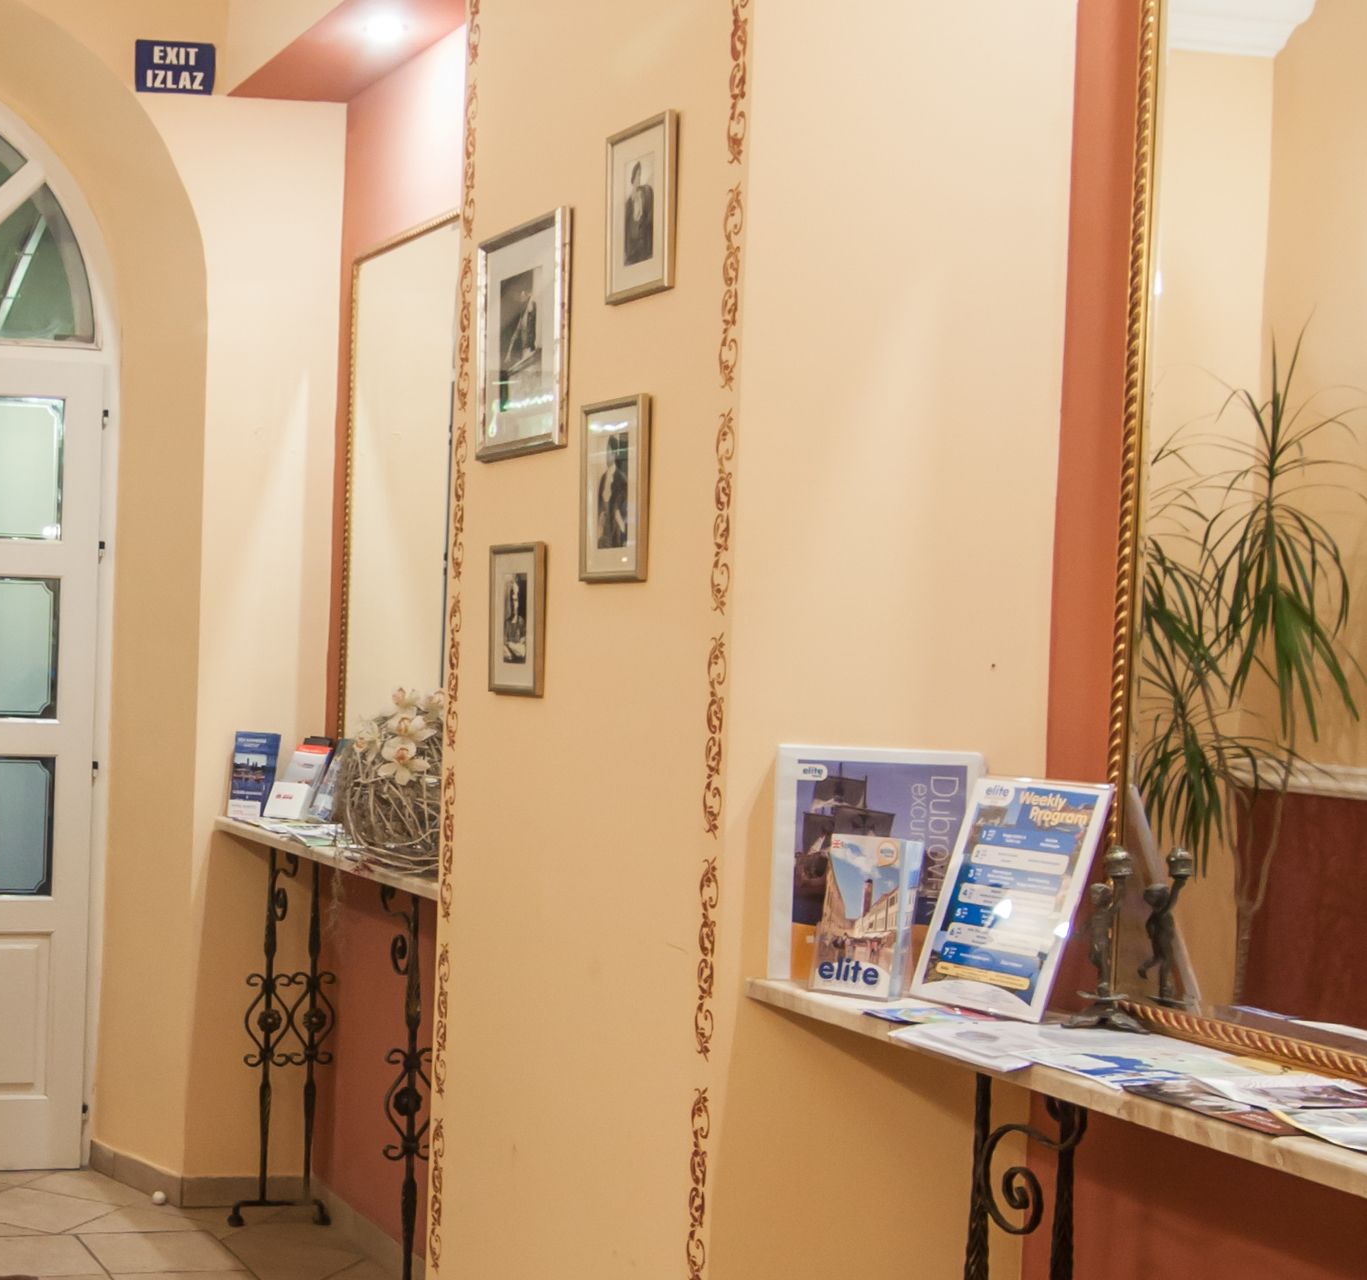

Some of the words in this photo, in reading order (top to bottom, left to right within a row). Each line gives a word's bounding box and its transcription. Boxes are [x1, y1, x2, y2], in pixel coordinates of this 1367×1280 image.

[153, 45, 199, 66] EXIT
[146, 69, 204, 90] IZLAZ
[802, 766, 823, 775] elite
[985, 784, 1010, 797] elite
[1019, 791, 1068, 811] Weekly
[910, 783, 927, 840] excur
[1029, 806, 1089, 827] Program
[818, 955, 879, 985] elite
